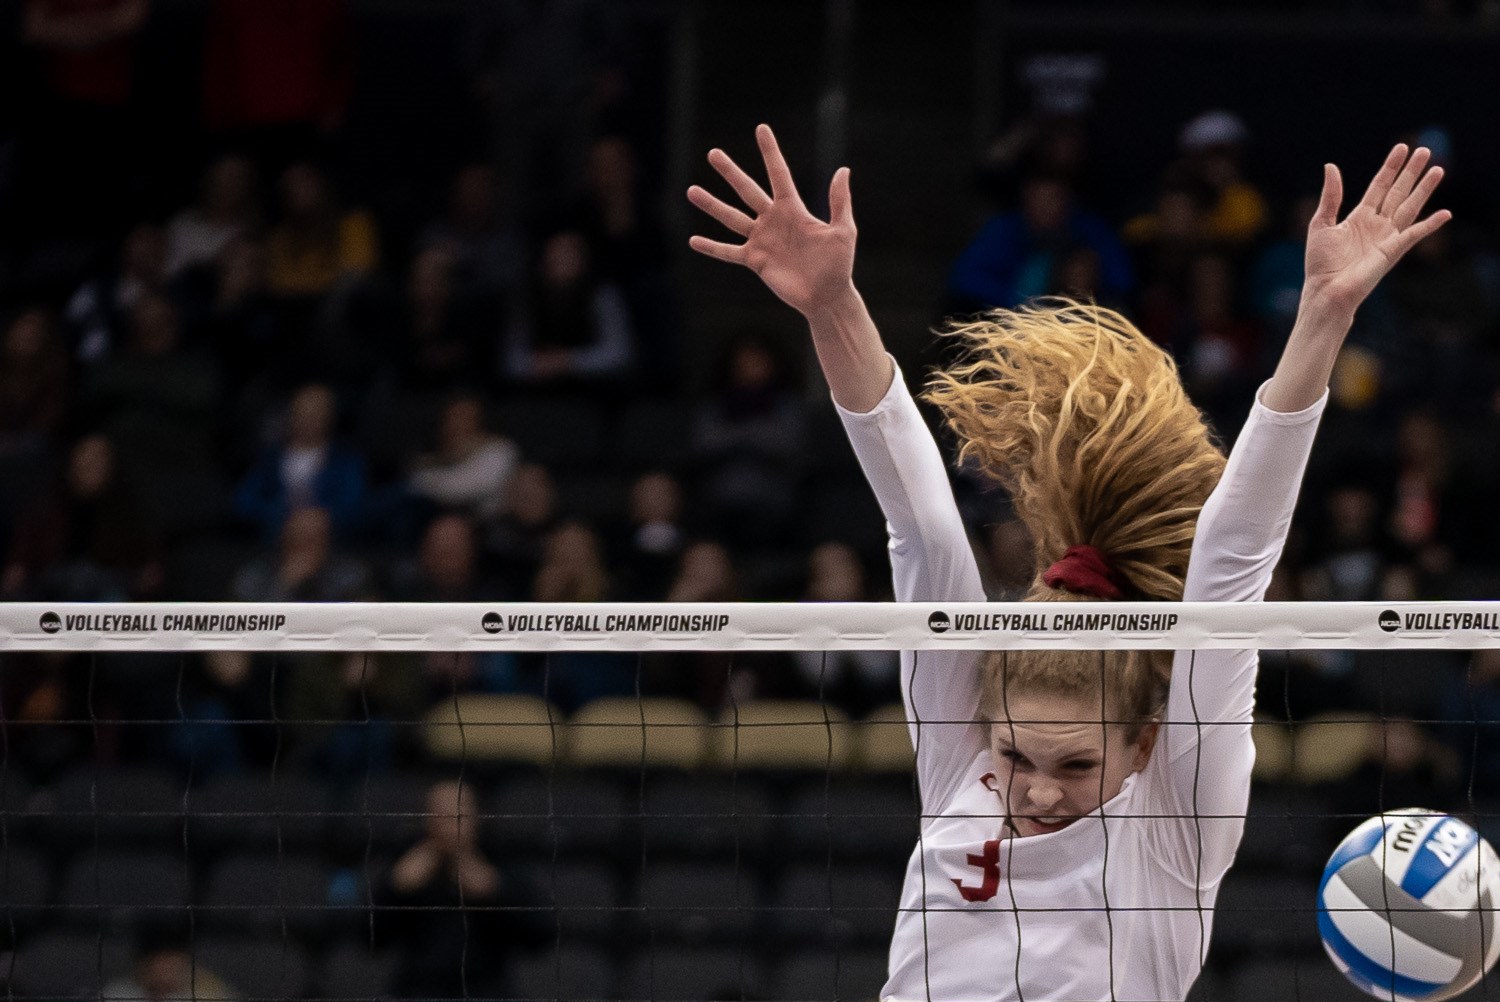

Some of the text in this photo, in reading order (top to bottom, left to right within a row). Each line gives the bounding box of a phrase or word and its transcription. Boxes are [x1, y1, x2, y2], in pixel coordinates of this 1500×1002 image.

[65, 614, 158, 631] VOLLEYBALL
[162, 614, 286, 631] CHAMPIONSHIP
[508, 614, 601, 632] VOLLEYBALL
[605, 614, 729, 632] CHAMPIONSHIP
[954, 614, 1048, 631] VOLLEYBALL
[1052, 613, 1178, 631] CHAMPIONSHIP
[1405, 613, 1500, 630] VOLLEYBALL
[950, 839, 1000, 902] 3
